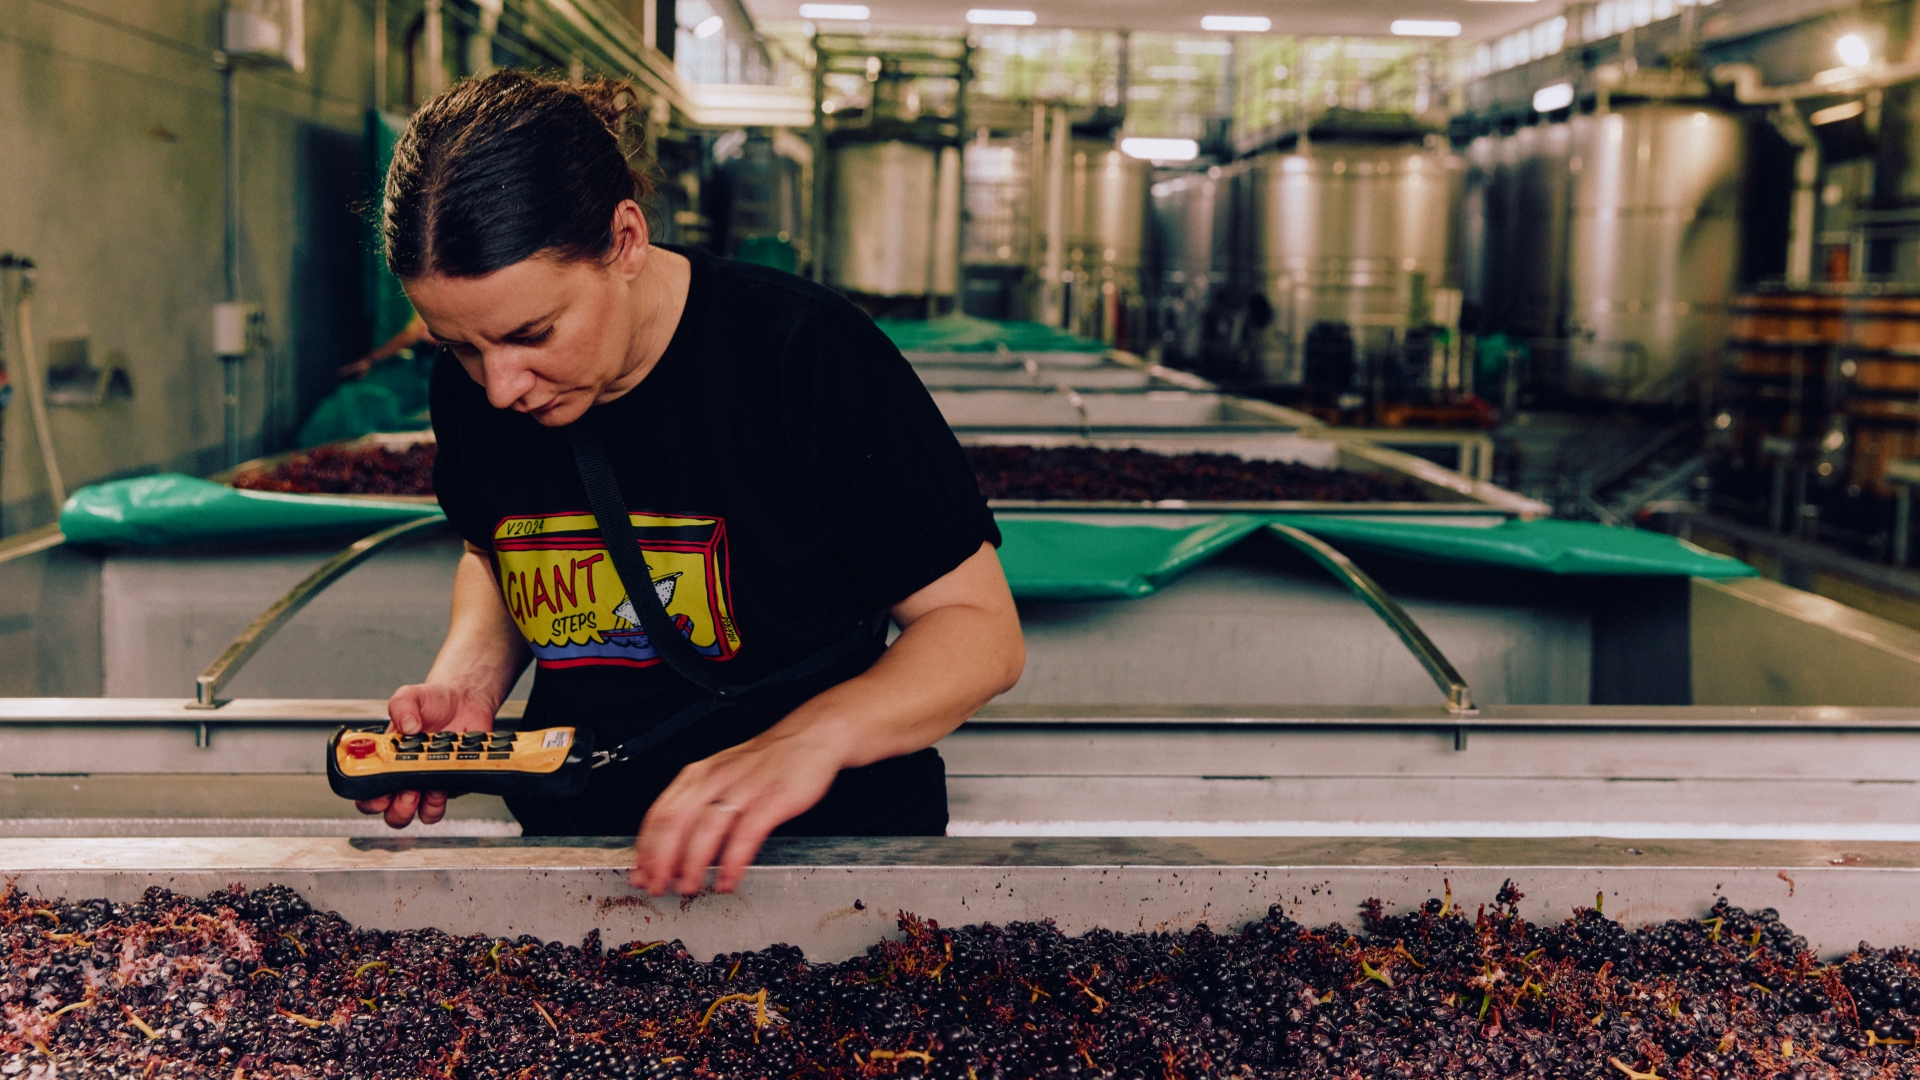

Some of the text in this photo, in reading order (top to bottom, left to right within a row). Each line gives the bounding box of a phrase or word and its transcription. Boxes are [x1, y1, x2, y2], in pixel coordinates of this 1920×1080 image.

[506, 518, 545, 536] V2024
[507, 553, 604, 625] GIANT
[551, 611, 597, 637] STEPS
